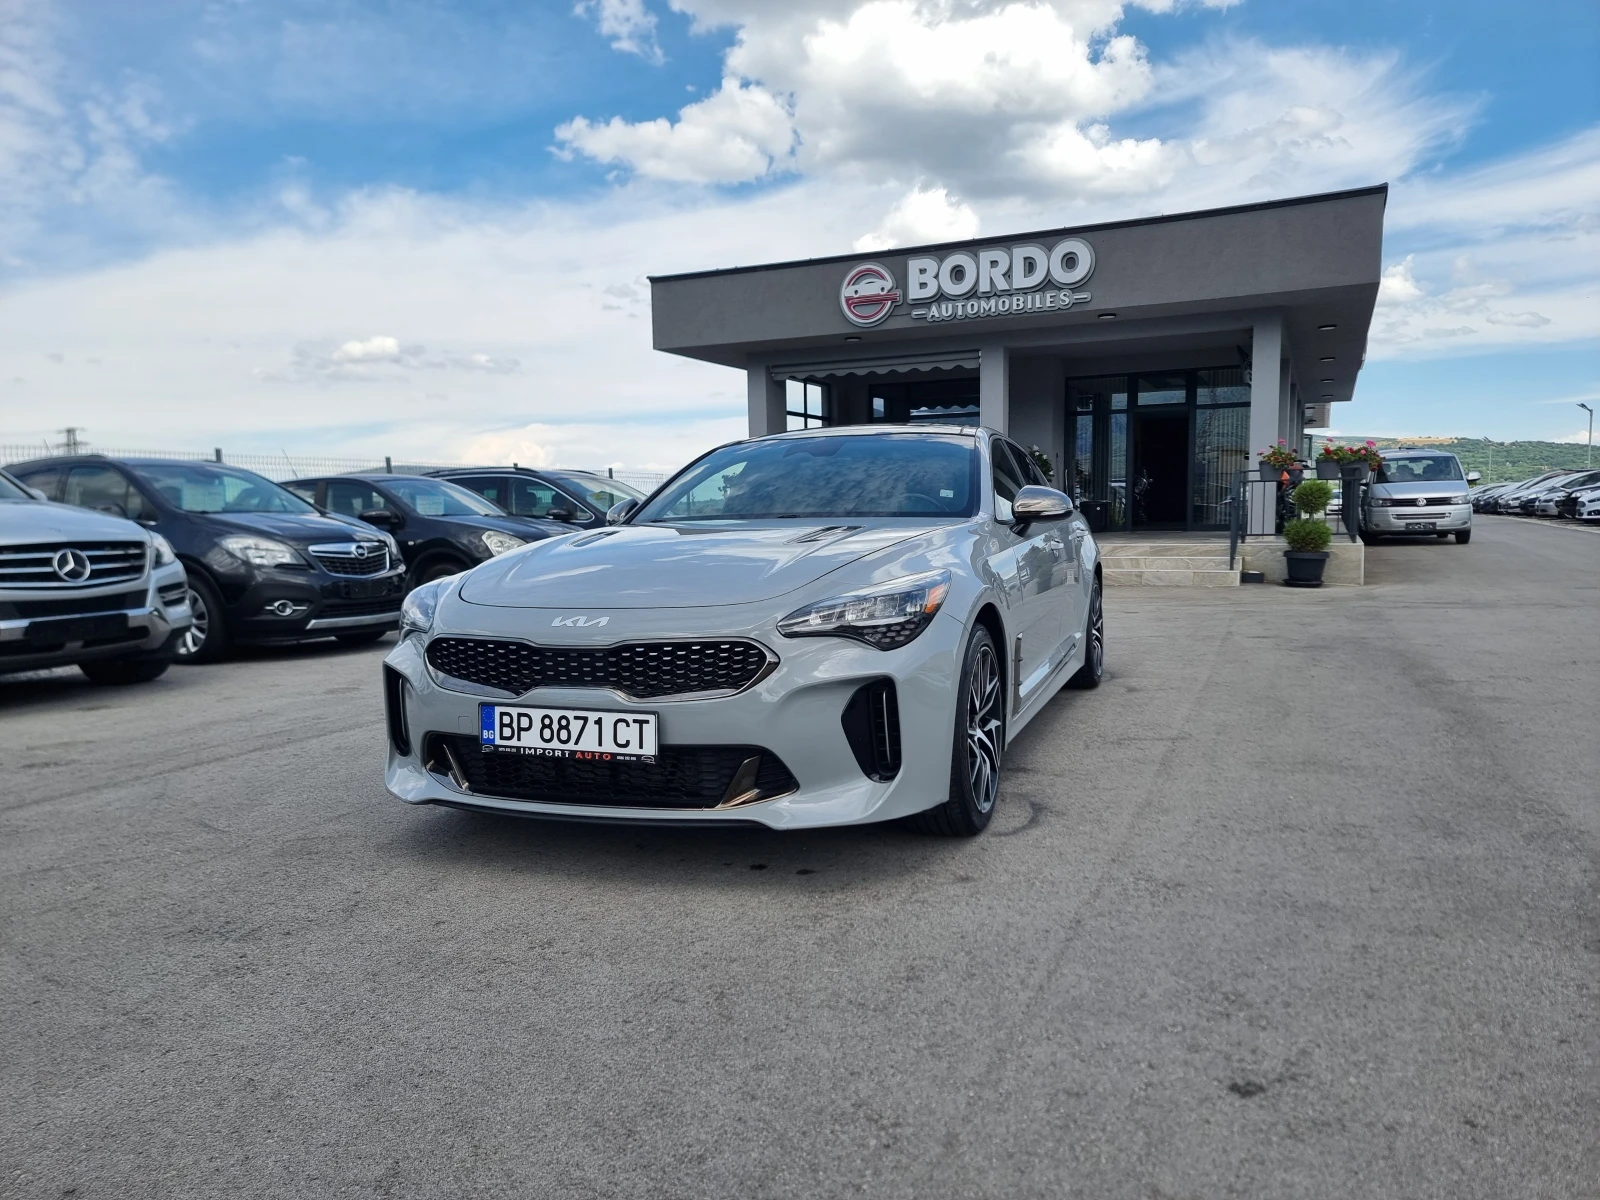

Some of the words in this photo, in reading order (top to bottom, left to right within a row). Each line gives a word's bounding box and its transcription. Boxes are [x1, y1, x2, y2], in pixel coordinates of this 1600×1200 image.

[908, 240, 1092, 299] BORDO
[928, 291, 1070, 319] AUTOMOBILES
[483, 729, 495, 739] BG
[499, 711, 533, 742] BP
[539, 713, 603, 747] 8871
[613, 718, 650, 750] CT
[520, 747, 570, 758] IMPORT
[575, 751, 612, 761] AUTO
